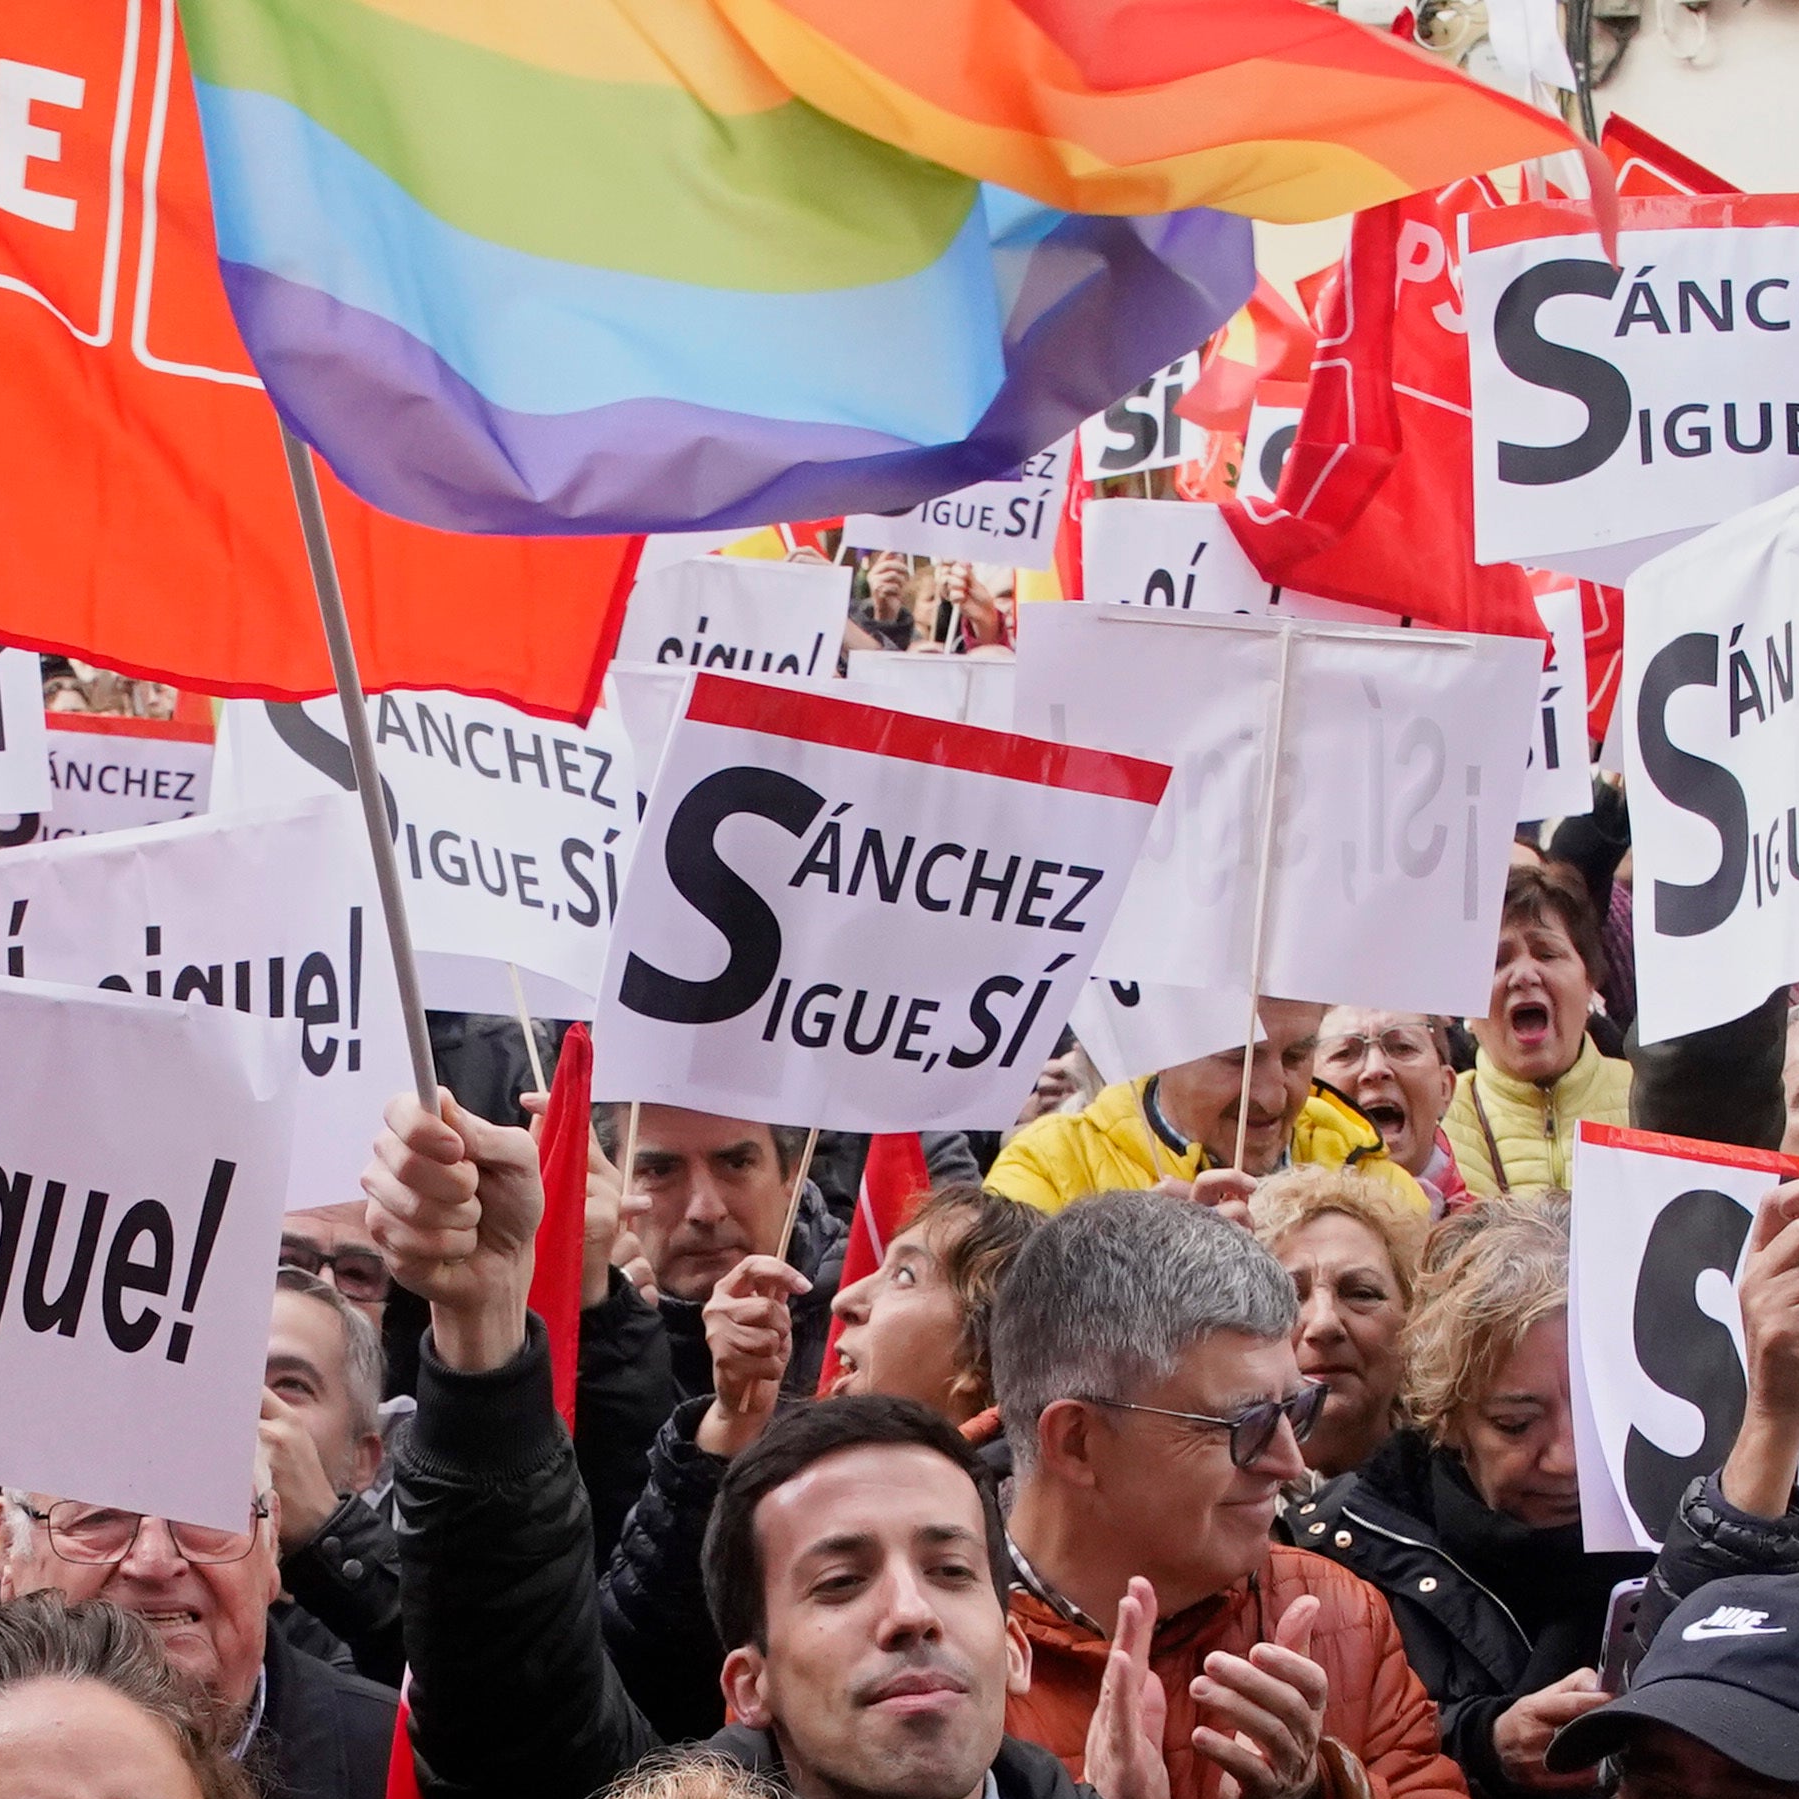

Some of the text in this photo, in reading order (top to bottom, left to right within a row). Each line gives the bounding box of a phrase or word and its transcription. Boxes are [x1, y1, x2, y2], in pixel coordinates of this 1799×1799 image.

[49, 751, 195, 801] ÁNCHEZ
[618, 766, 1104, 1024] SÁNCHEZ
[947, 953, 1075, 1070] SÍ
[1703, 1605, 1770, 1630] NIKE
